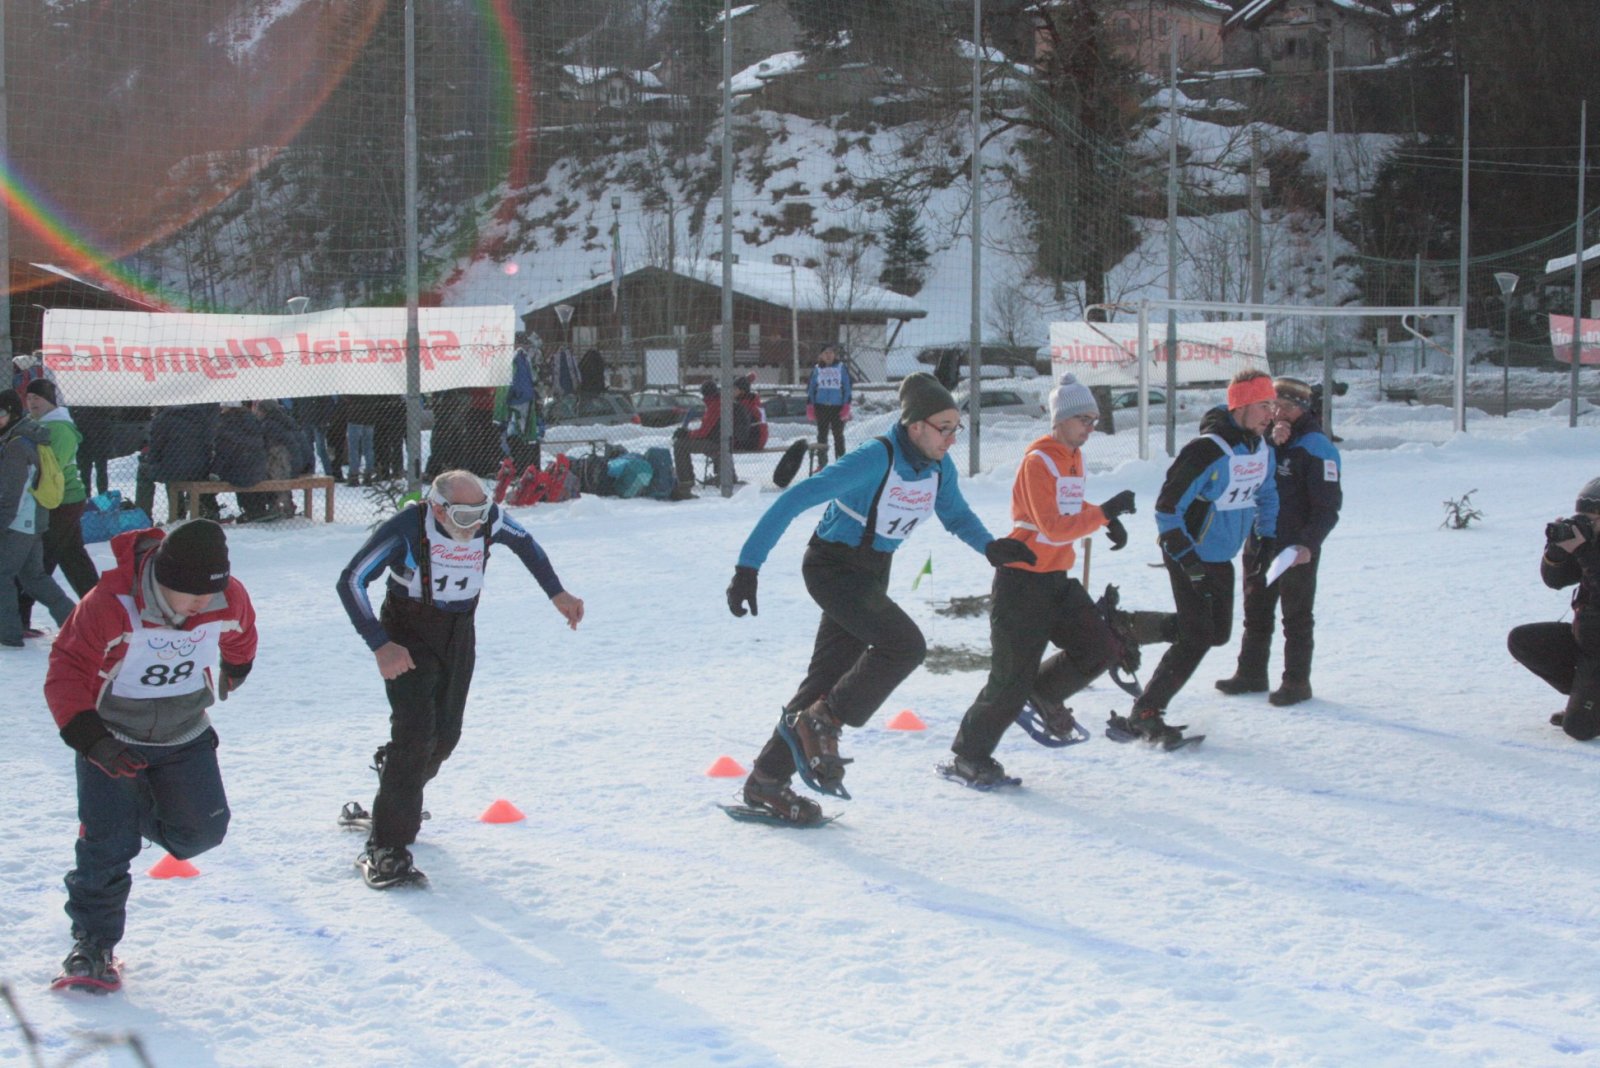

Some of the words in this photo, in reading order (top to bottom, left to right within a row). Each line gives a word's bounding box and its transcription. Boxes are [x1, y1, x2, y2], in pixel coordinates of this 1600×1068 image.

[887, 517, 919, 535] 14
[434, 575, 469, 592] 11
[140, 660, 195, 686] 88
